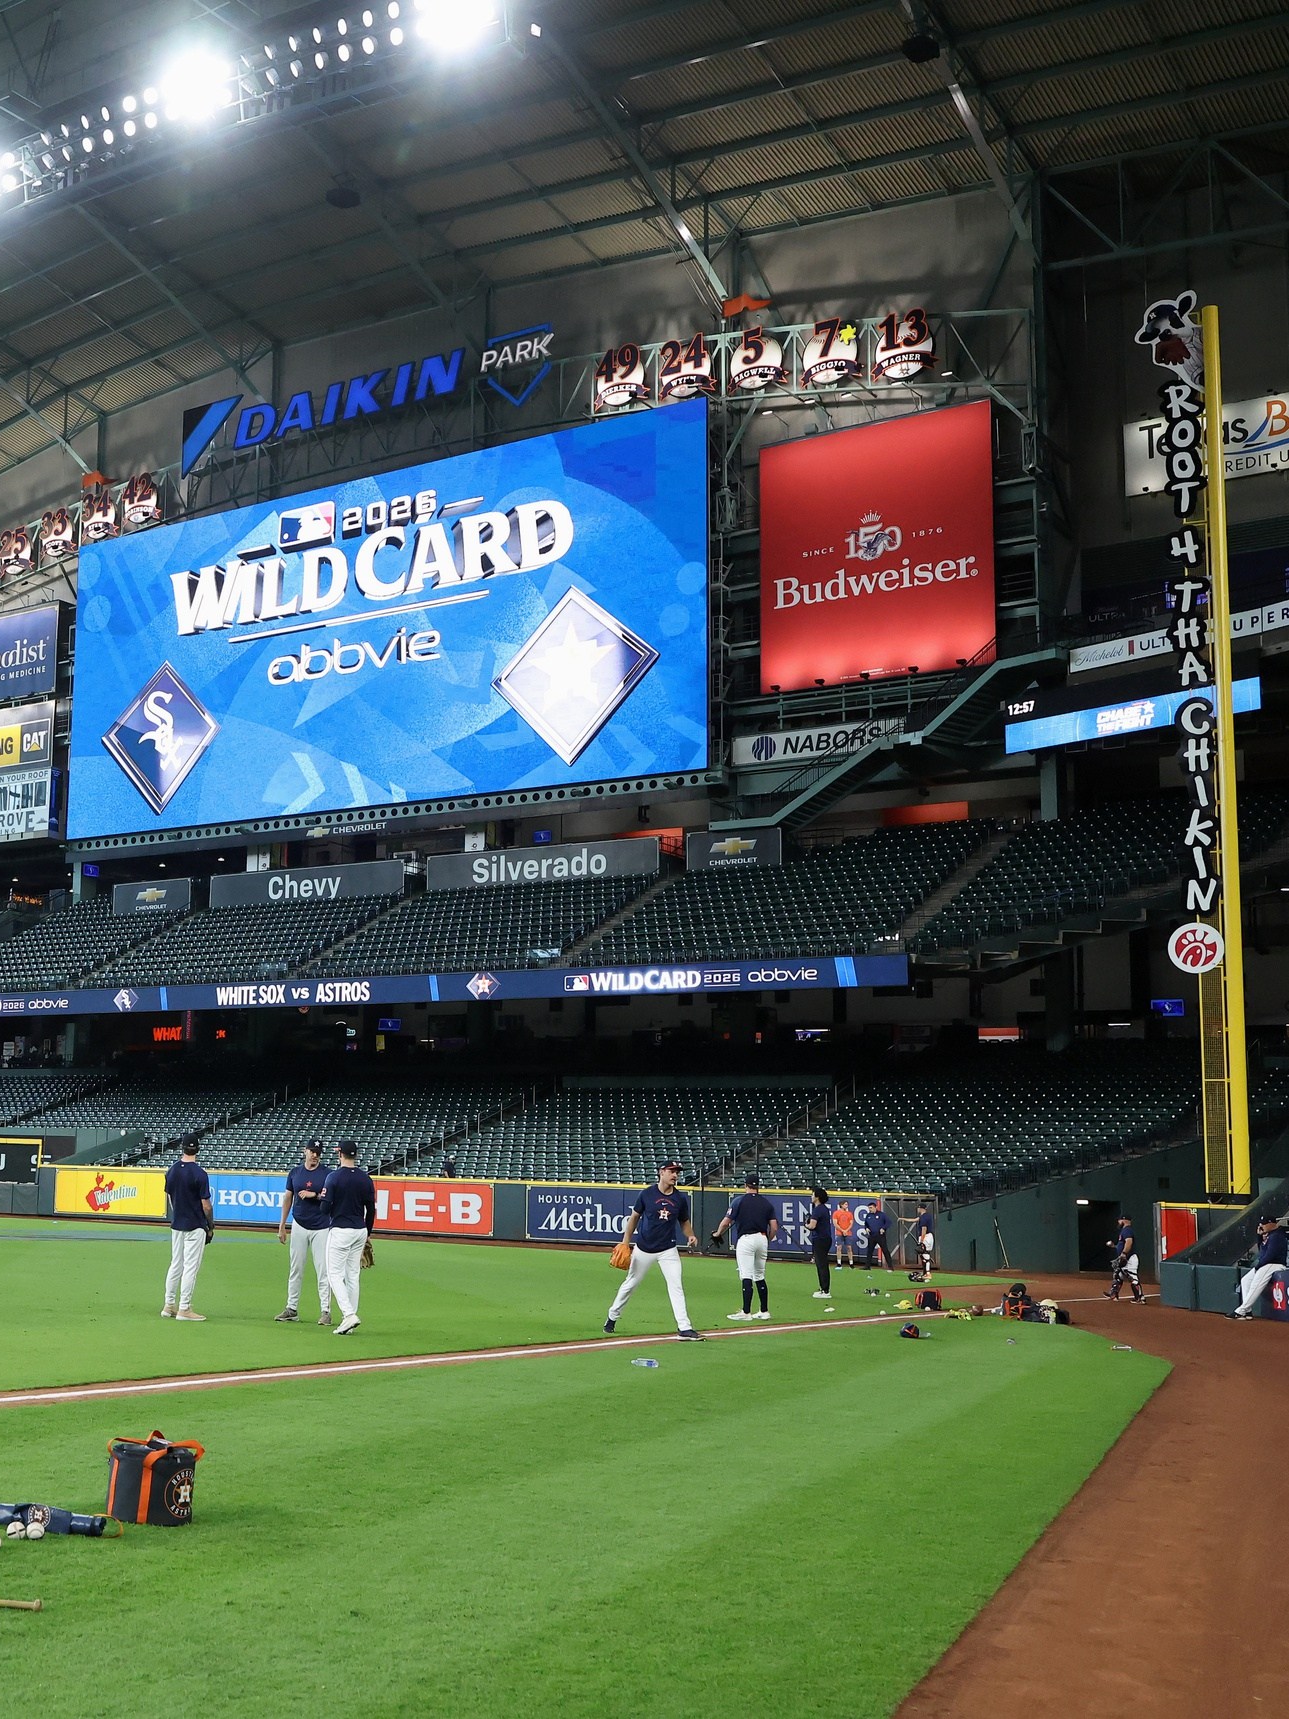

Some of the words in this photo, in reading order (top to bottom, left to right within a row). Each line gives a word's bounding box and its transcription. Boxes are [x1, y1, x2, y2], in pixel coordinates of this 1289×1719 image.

[742, 327, 764, 365] 5
[814, 318, 840, 359] 7
[878, 308, 928, 353] 13
[480, 332, 555, 373] PARK
[595, 343, 640, 383] 49
[660, 332, 707, 377] 24
[881, 354, 920, 368] WAGNER
[233, 348, 466, 450] DAIKIN
[1164, 384, 1200, 513] ROOT
[123, 472, 153, 504] 42
[82, 489, 111, 522] 34
[342, 490, 437, 536] 2026
[39, 508, 68, 539] 33
[802, 546, 834, 558] SINCE
[912, 527, 943, 538] 1876
[773, 555, 976, 610] Budweiser
[1173, 580, 1207, 687] THA
[267, 626, 441, 686] abbvie
[1074, 644, 1124, 667] Michelob
[8, 665, 46, 680] MEDICINE
[1008, 700, 1035, 716] 12:57
[22, 730, 47, 752] CAT
[783, 726, 882, 755] NABORS
[7, 774, 26, 783] YOUR
[28, 770, 49, 779] ROOF
[1180, 701, 1217, 912] CHIKIN
[332, 822, 387, 835] CHEVROLET
[472, 847, 607, 884] Silverado
[709, 856, 759, 867] CHEVROLET
[268, 874, 341, 900] Chevy
[135, 903, 167, 911] CHEVROLET
[703, 972, 741, 983] 2026
[748, 967, 818, 983] abbvie
[3, 1001, 25, 1010] 2026
[28, 998, 69, 1010] abbvie
[216, 985, 257, 1006] WHITE
[259, 984, 286, 1004] SOX
[315, 981, 370, 1003] ASTROS
[93, 1184, 137, 1206] Valentina
[538, 1194, 592, 1205] HOUSTON
